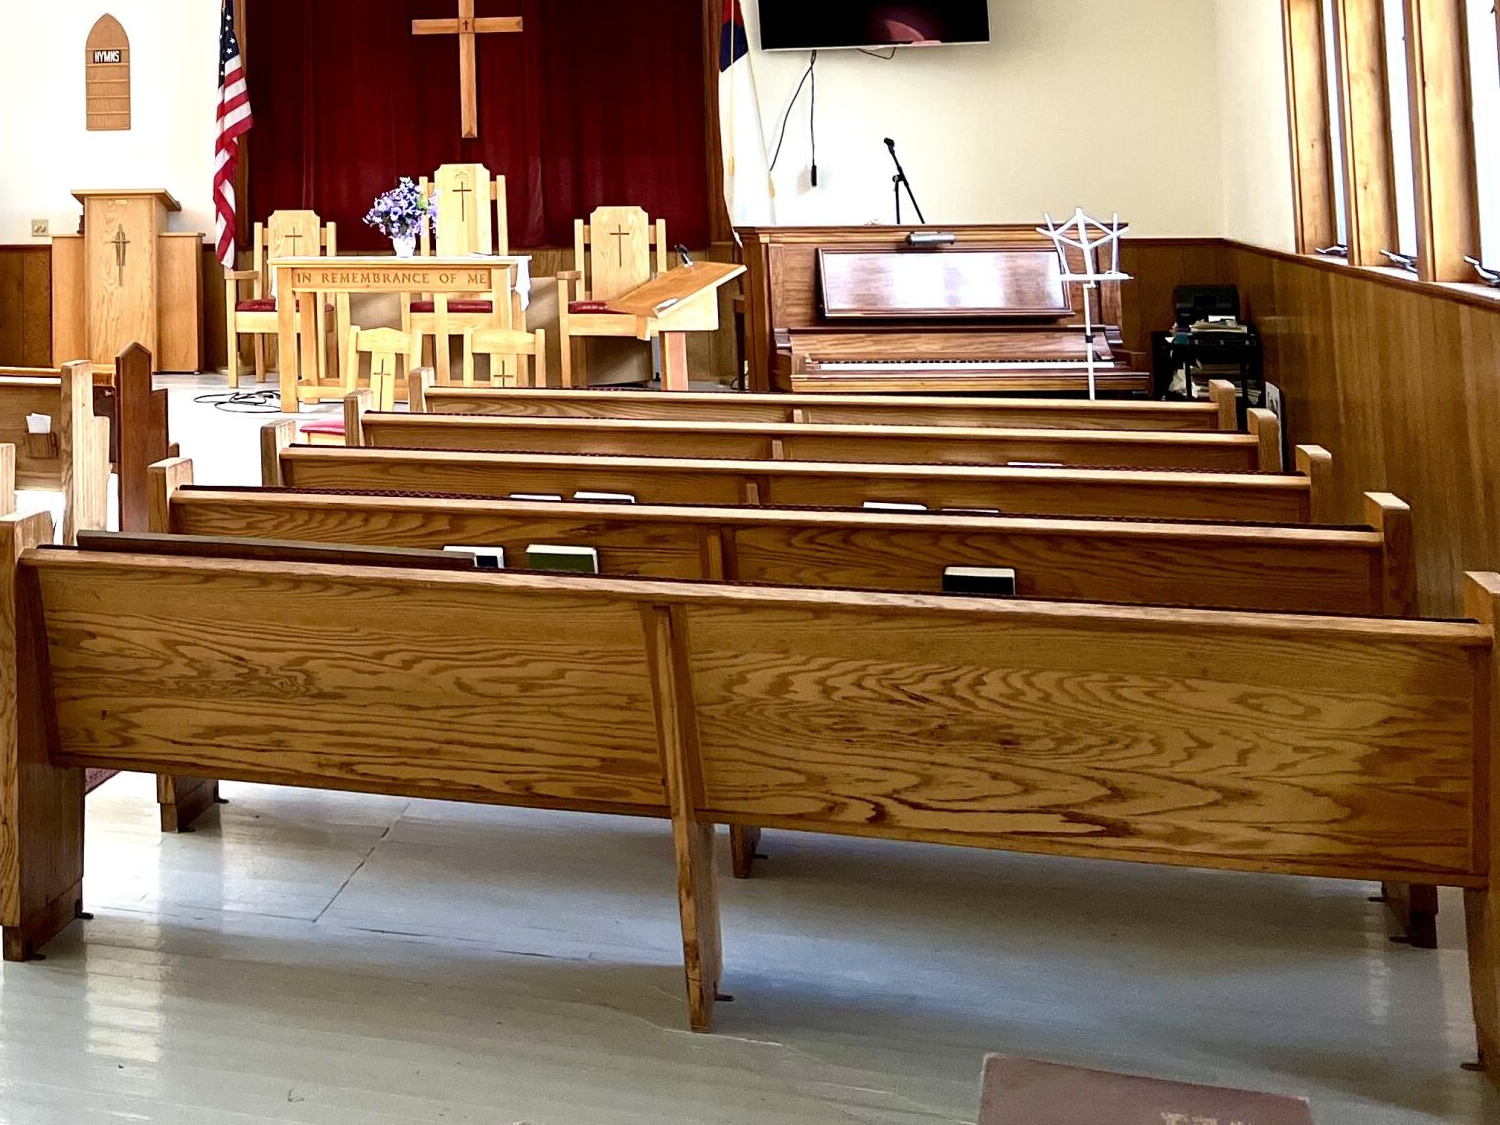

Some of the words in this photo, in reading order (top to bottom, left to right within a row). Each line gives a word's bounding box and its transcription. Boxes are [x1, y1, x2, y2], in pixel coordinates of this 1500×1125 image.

[94, 50, 120, 63] HYMNS
[297, 272, 312, 284] IN
[321, 272, 430, 284] REMEMBRANCE
[439, 272, 457, 284] OF
[467, 272, 488, 284] ME
